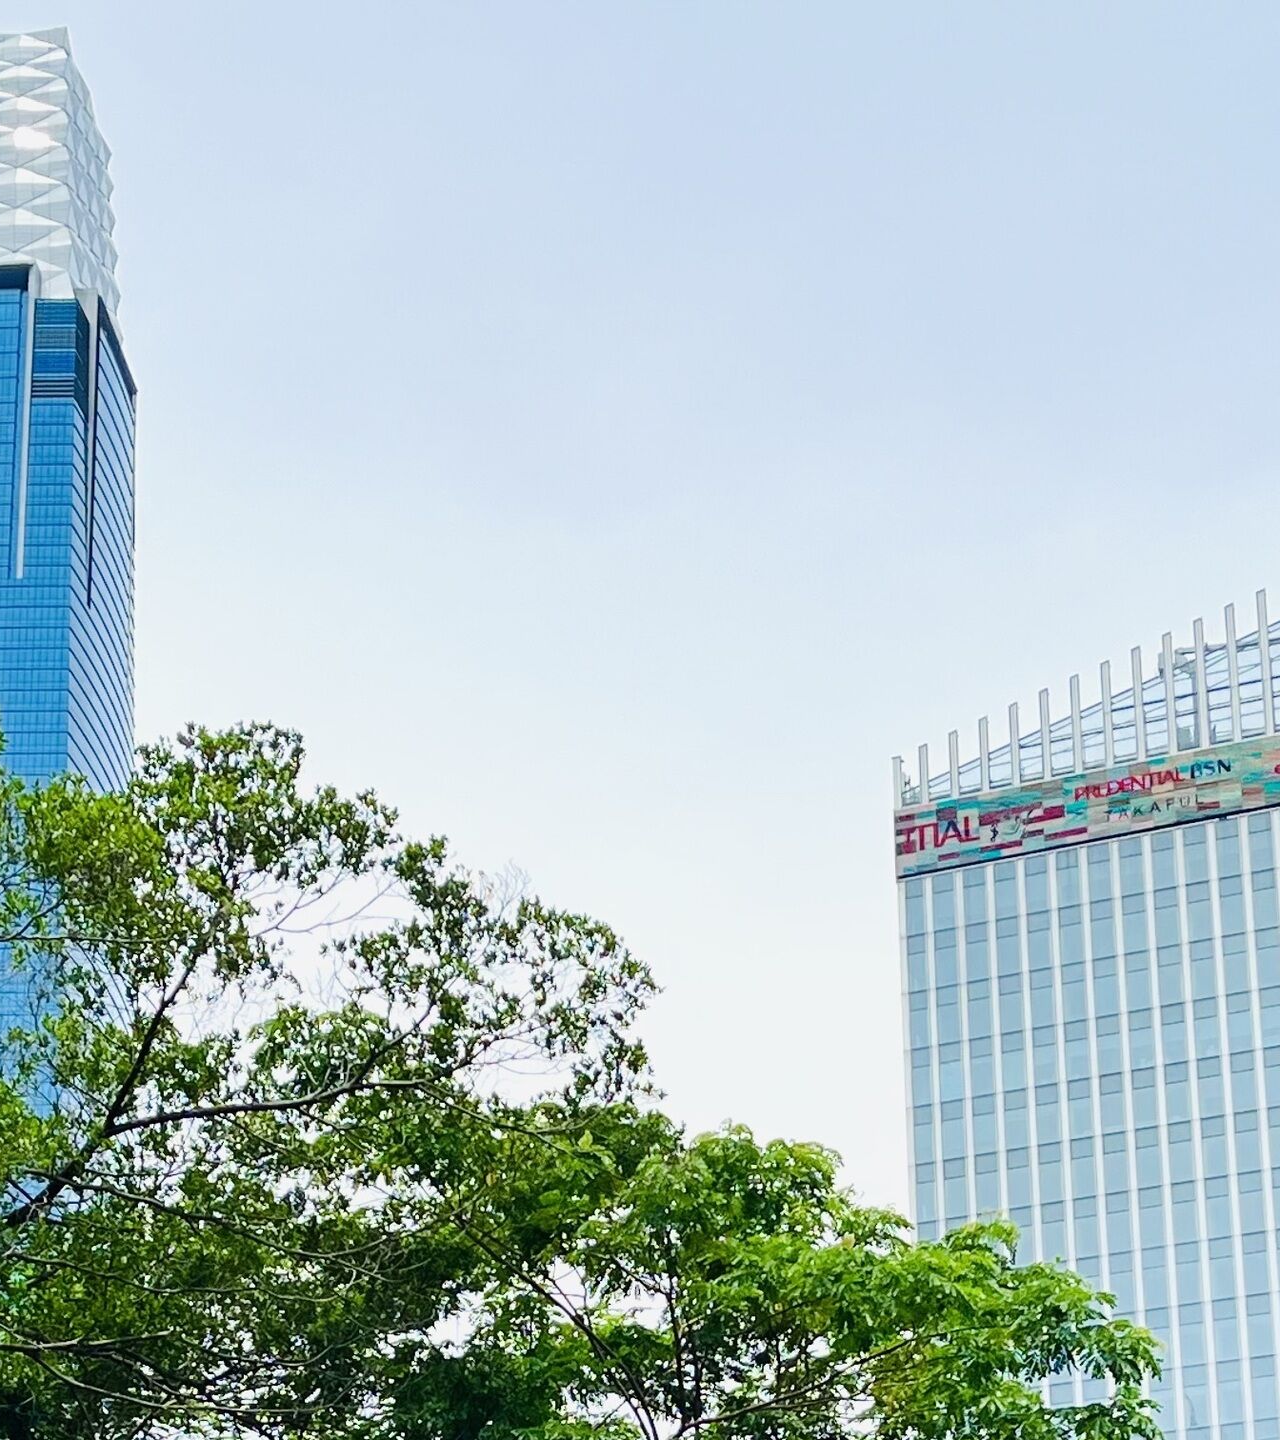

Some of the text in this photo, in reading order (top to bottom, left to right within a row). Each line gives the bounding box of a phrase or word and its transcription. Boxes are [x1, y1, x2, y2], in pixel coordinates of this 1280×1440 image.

[1074, 758, 1232, 801] PRUDENTIAL BSN
[1104, 793, 1205, 822] TAKAFUL
